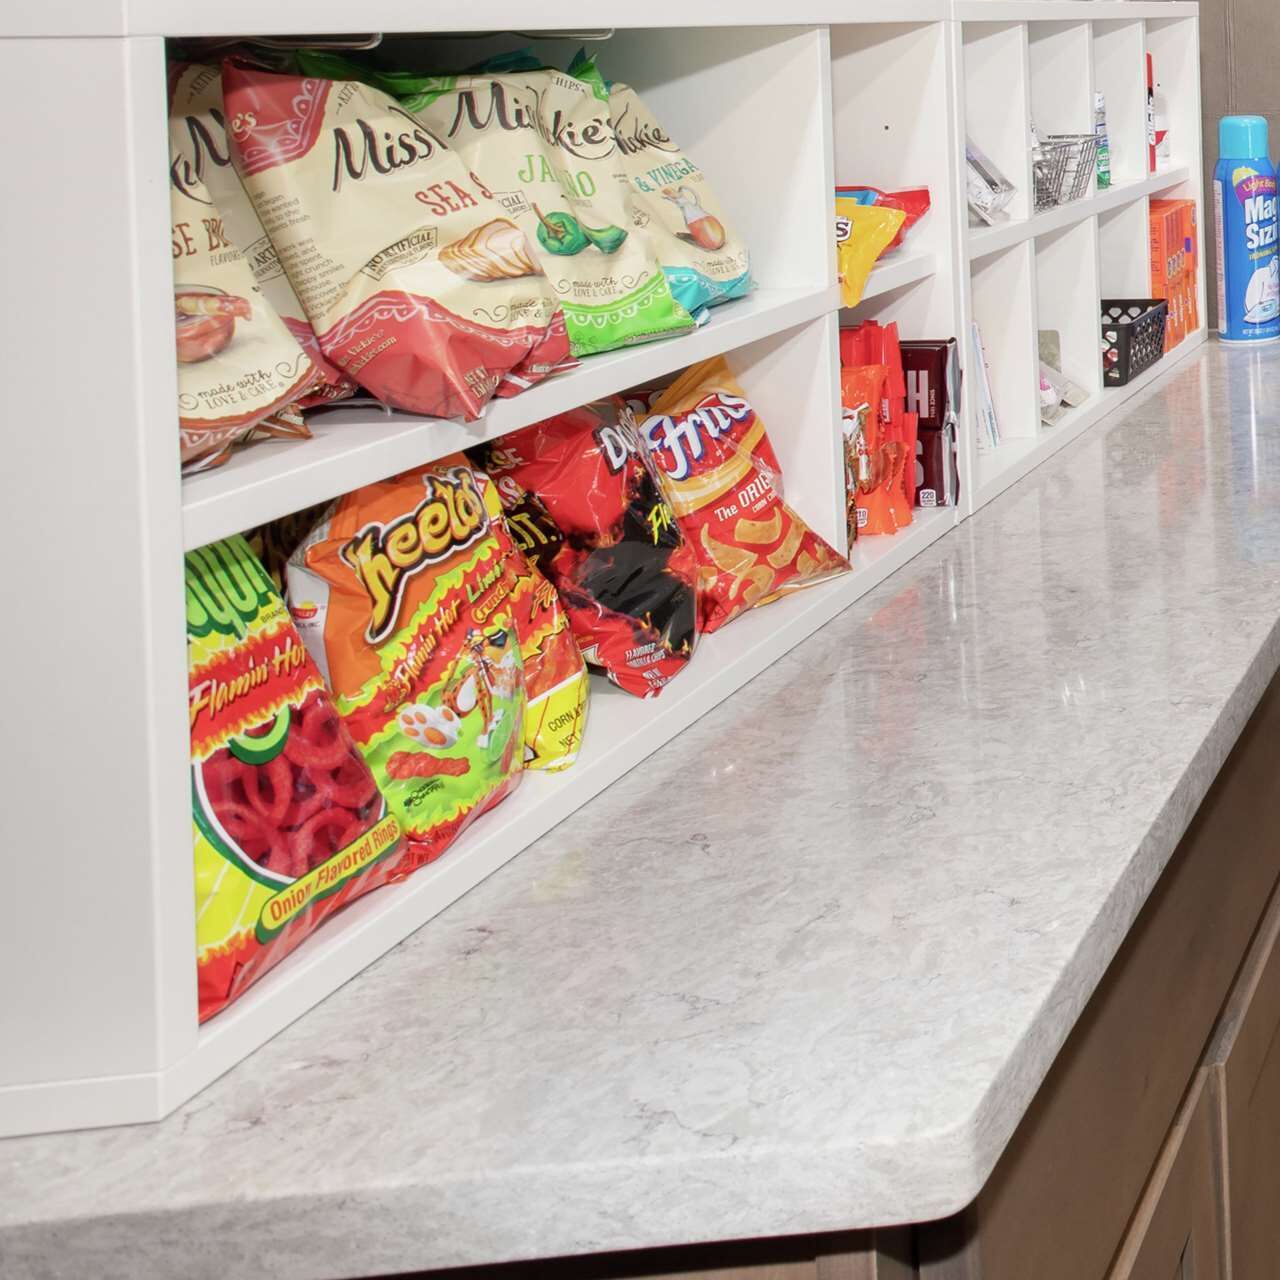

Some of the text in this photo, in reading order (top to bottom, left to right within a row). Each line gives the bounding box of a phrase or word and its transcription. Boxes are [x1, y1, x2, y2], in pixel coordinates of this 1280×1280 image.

[332, 119, 432, 192] Miss
[415, 179, 471, 217] SEA
[1241, 178, 1264, 193] Light
[572, 277, 618, 288] made with
[236, 369, 272, 390] with
[205, 392, 237, 410] LOVE
[248, 378, 278, 399] CARE
[714, 504, 739, 522] The
[434, 597, 461, 635] Hot
[547, 709, 574, 733] CORN
[270, 881, 312, 923] Onion
[313, 841, 371, 895] Flavored
[370, 819, 398, 858] Rings
